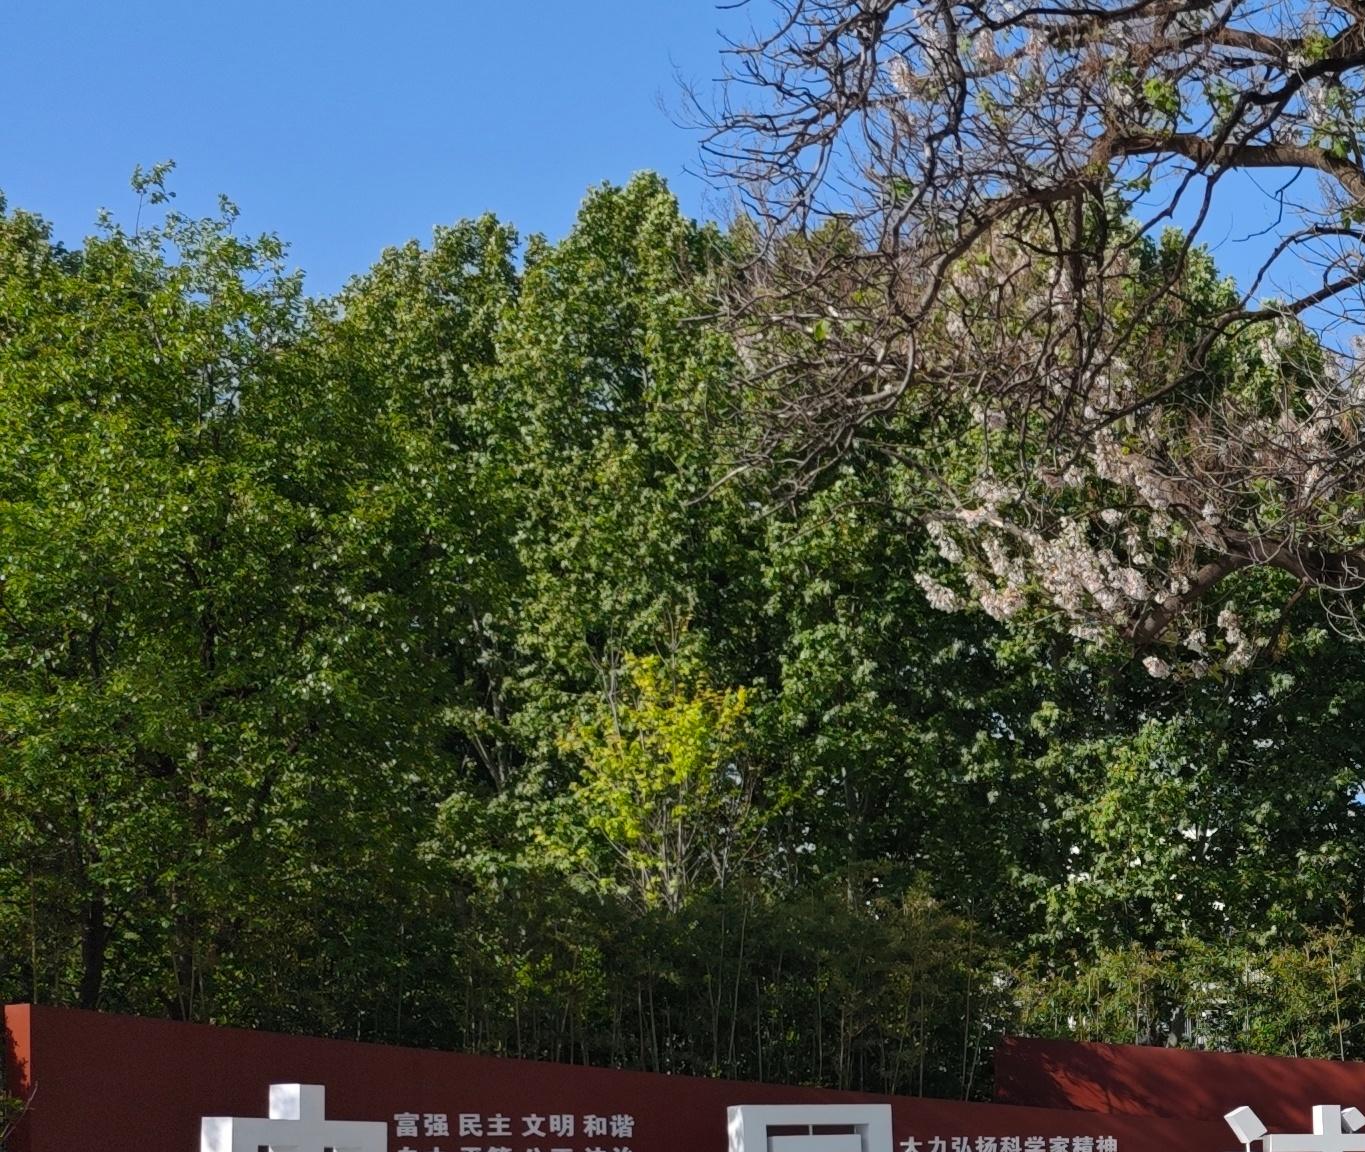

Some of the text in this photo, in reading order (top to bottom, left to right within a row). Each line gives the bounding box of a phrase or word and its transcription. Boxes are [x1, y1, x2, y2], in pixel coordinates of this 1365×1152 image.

[393, 1112, 636, 1139] 富强 民主 文明 和谐
